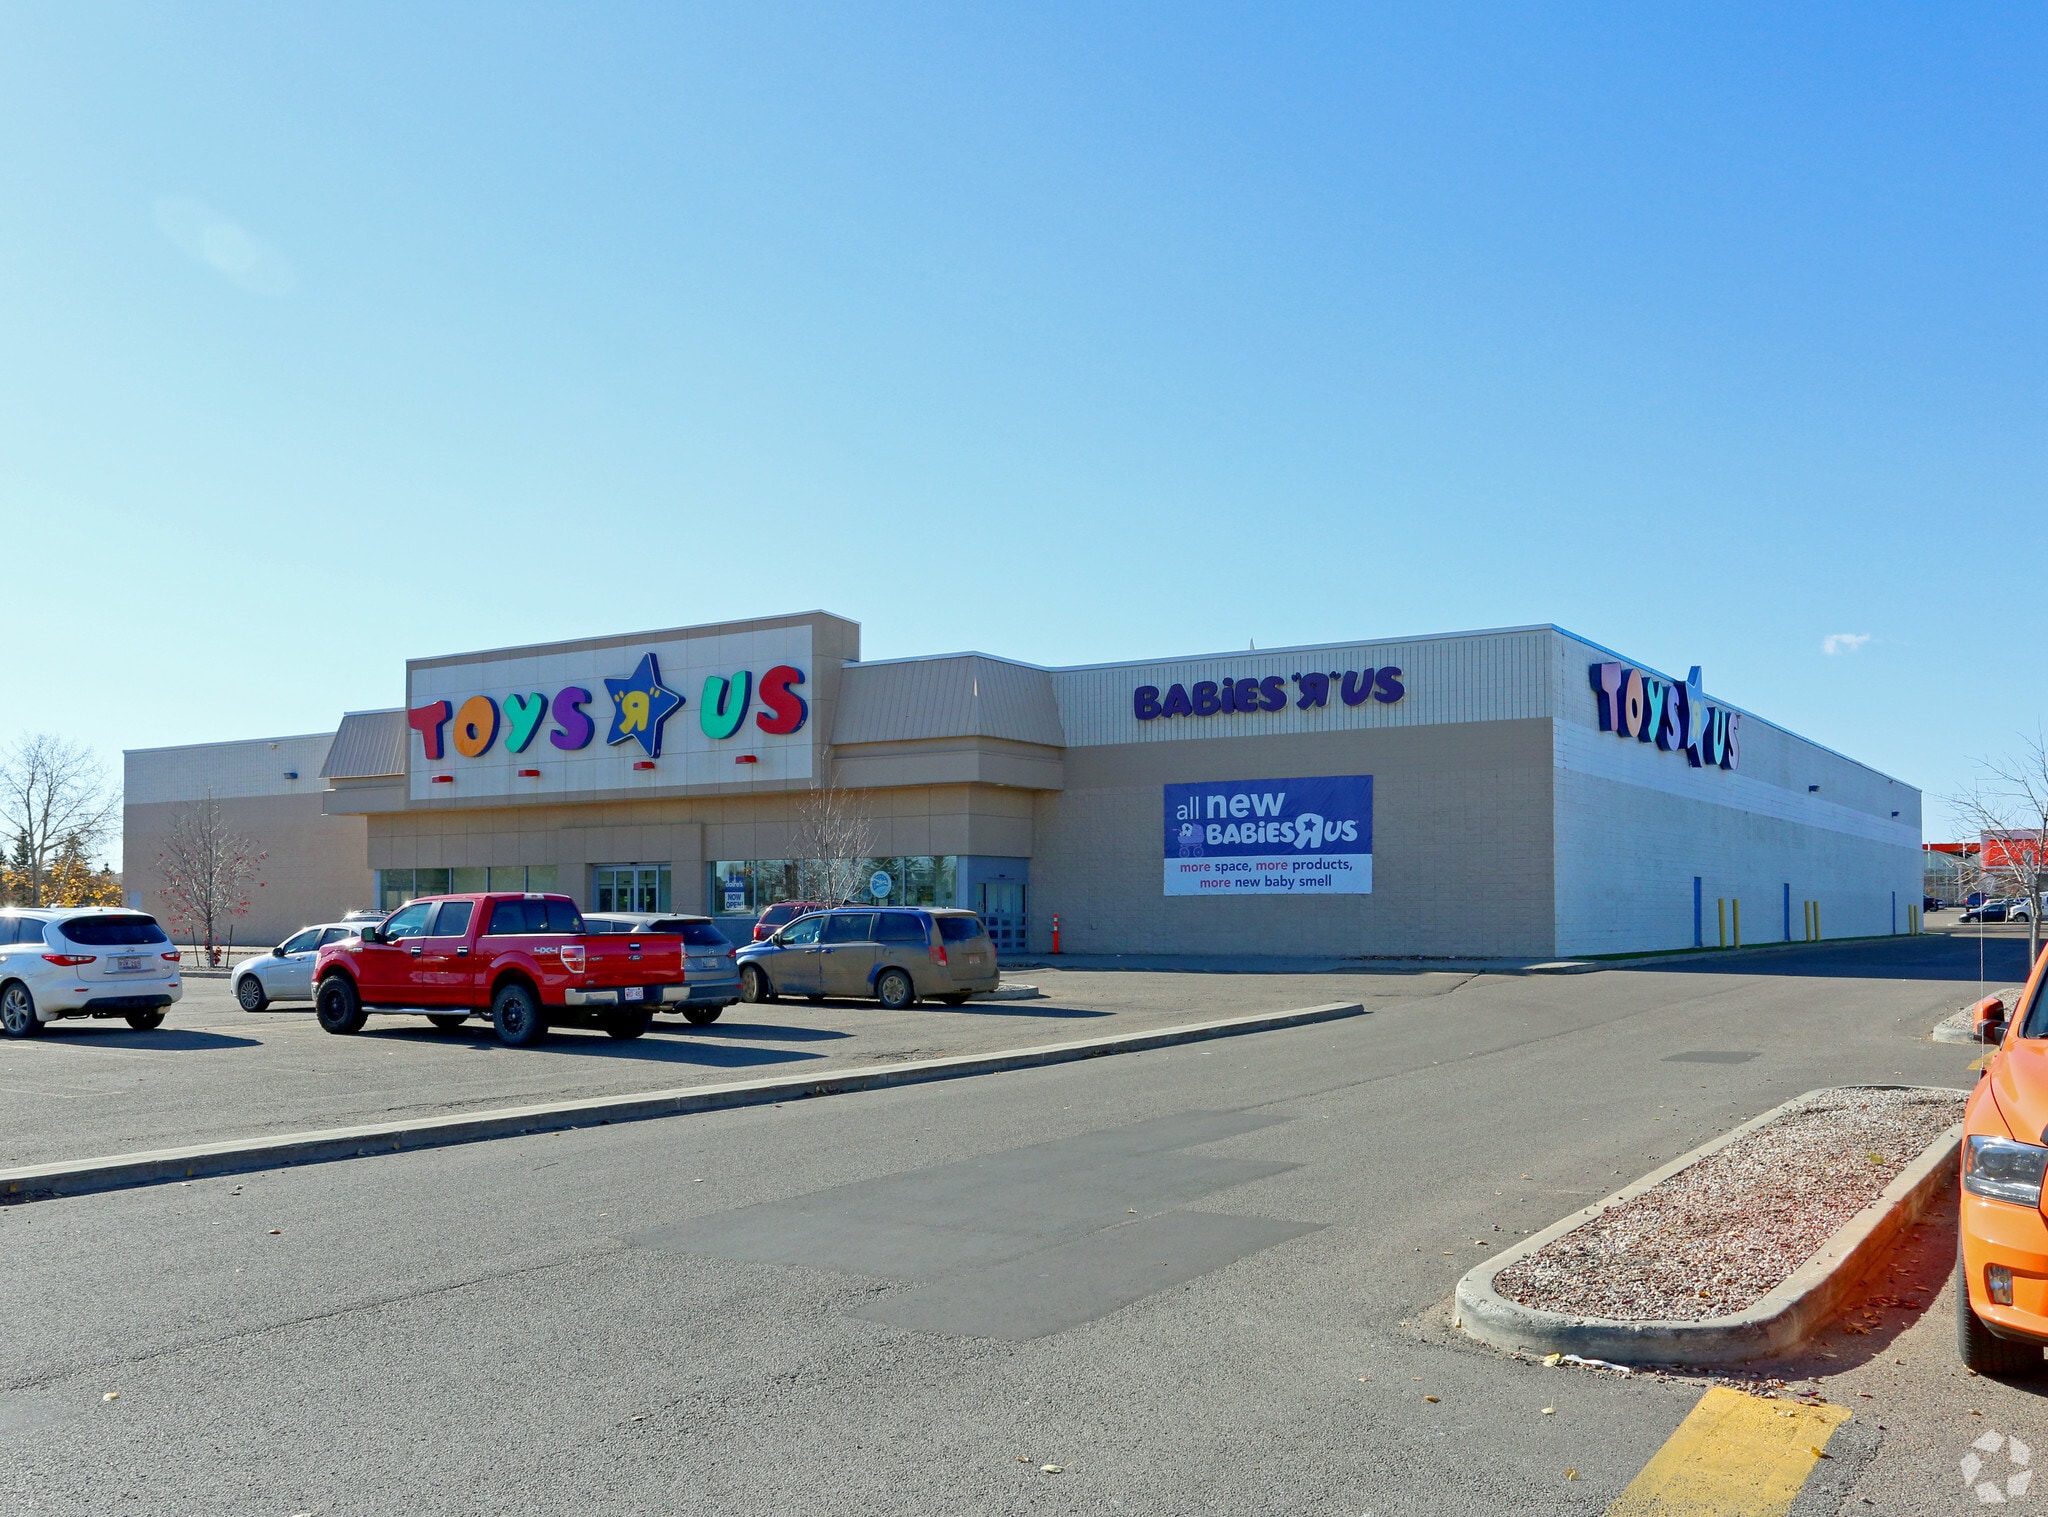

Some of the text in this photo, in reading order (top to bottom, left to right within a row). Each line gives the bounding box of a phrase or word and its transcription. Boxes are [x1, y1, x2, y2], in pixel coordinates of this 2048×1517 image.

[1341, 666, 1406, 706] US
[408, 686, 597, 760] TOYS
[699, 665, 811, 740] US
[1589, 661, 1681, 751] TOYS
[1704, 707, 1740, 770] US
[1176, 792, 1285, 820] all new
[1180, 858, 1353, 875] more space, more products,
[1200, 875, 1332, 889] more new baby smell
